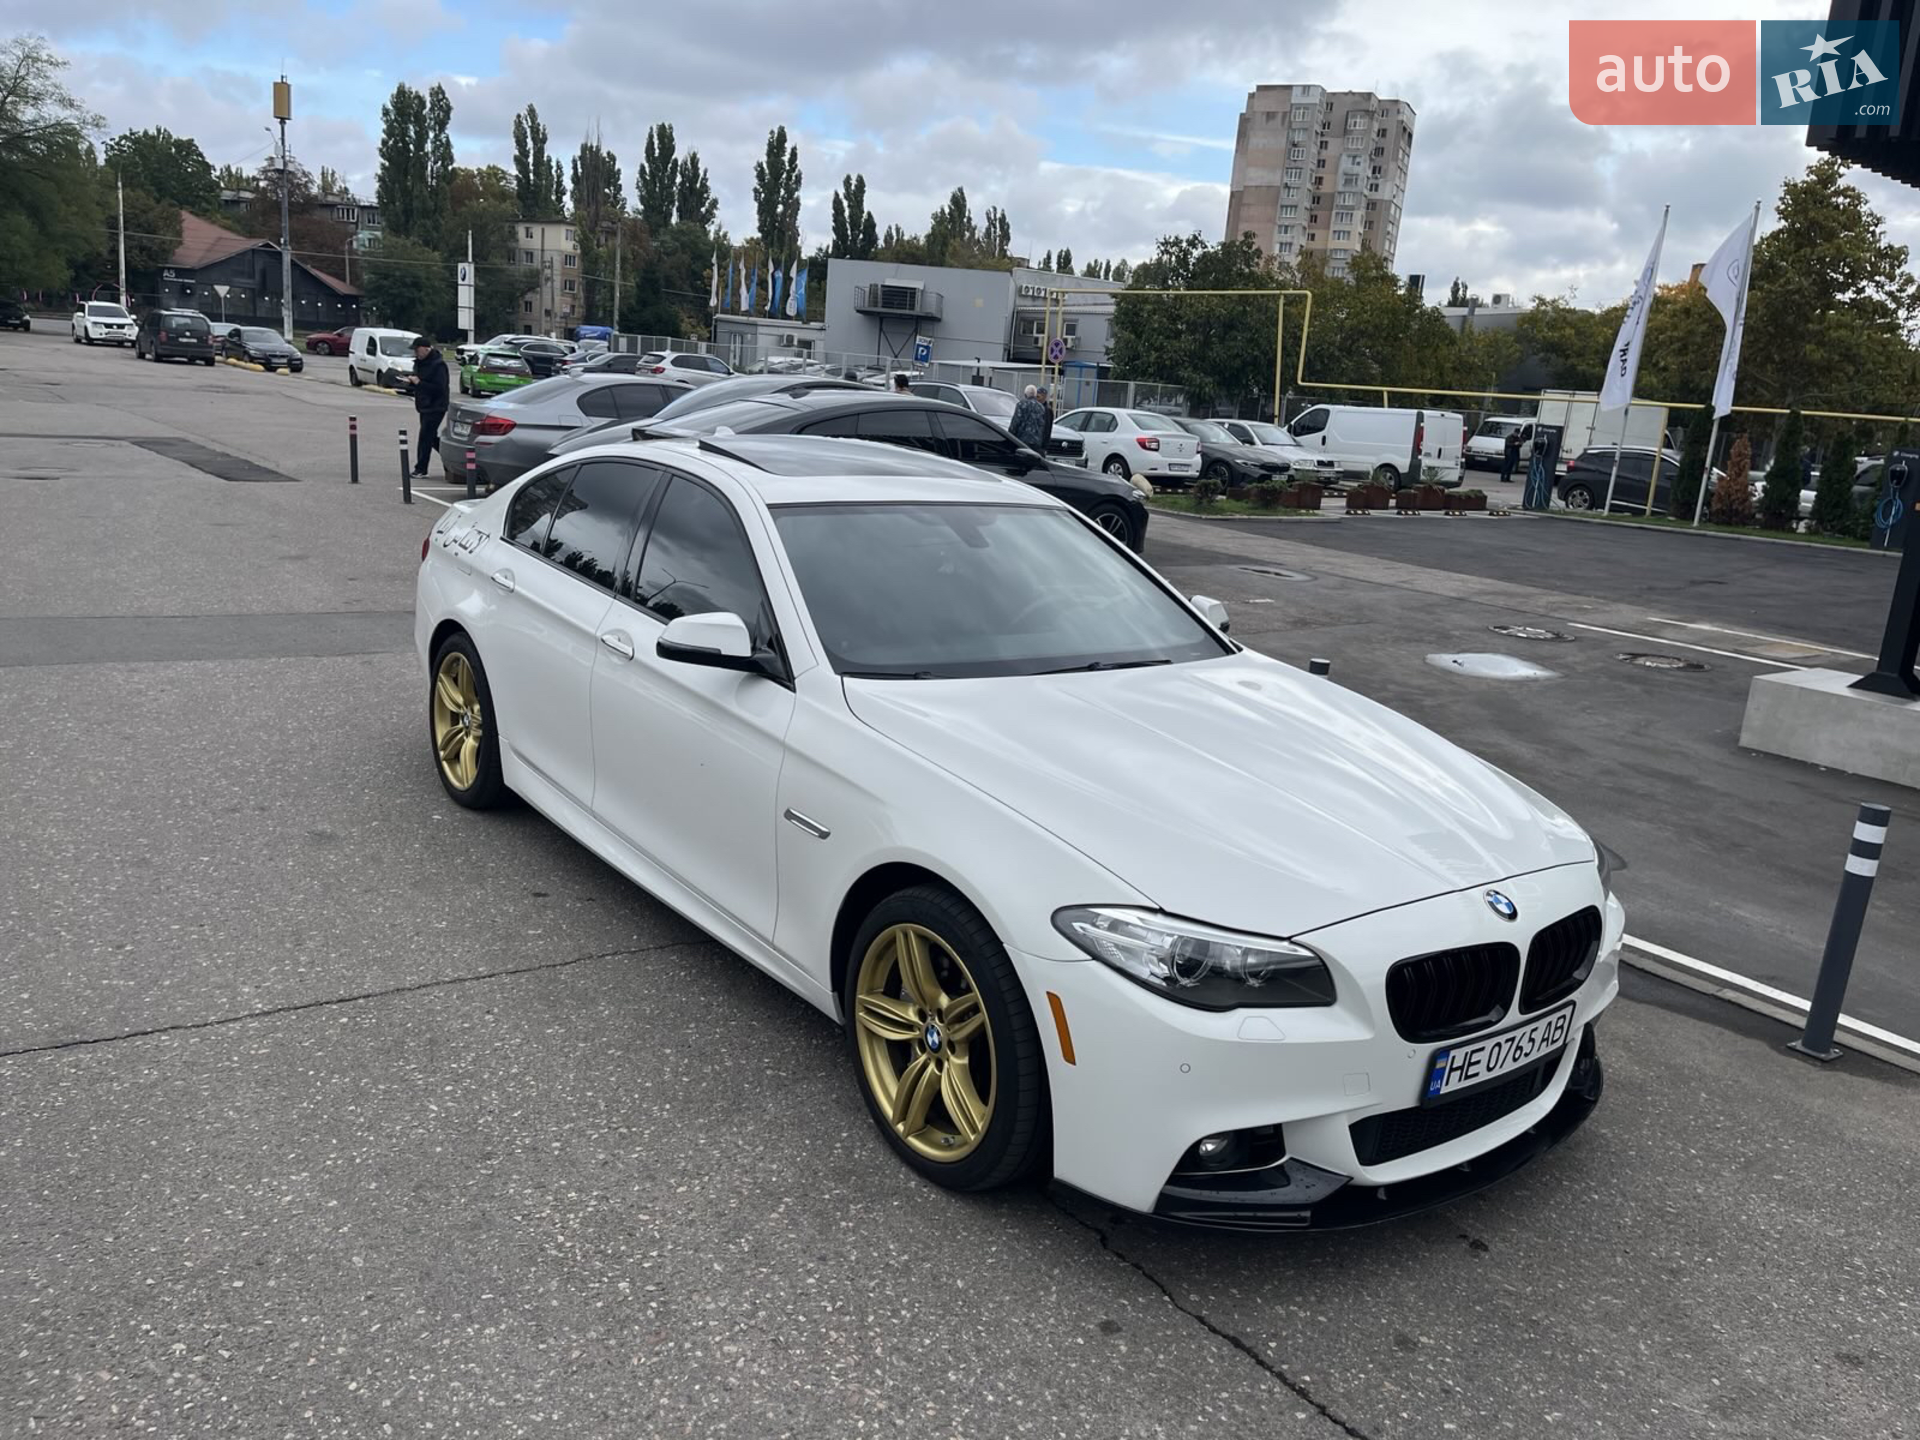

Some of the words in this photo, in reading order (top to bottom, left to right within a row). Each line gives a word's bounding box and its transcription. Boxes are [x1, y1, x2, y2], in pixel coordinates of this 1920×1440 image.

[918, 347, 927, 359] P
[1445, 1046, 1485, 1086] HE
[1486, 1027, 1538, 1072] 0765
[1537, 1014, 1566, 1052] AB
[1430, 1080, 1441, 1091] UA
